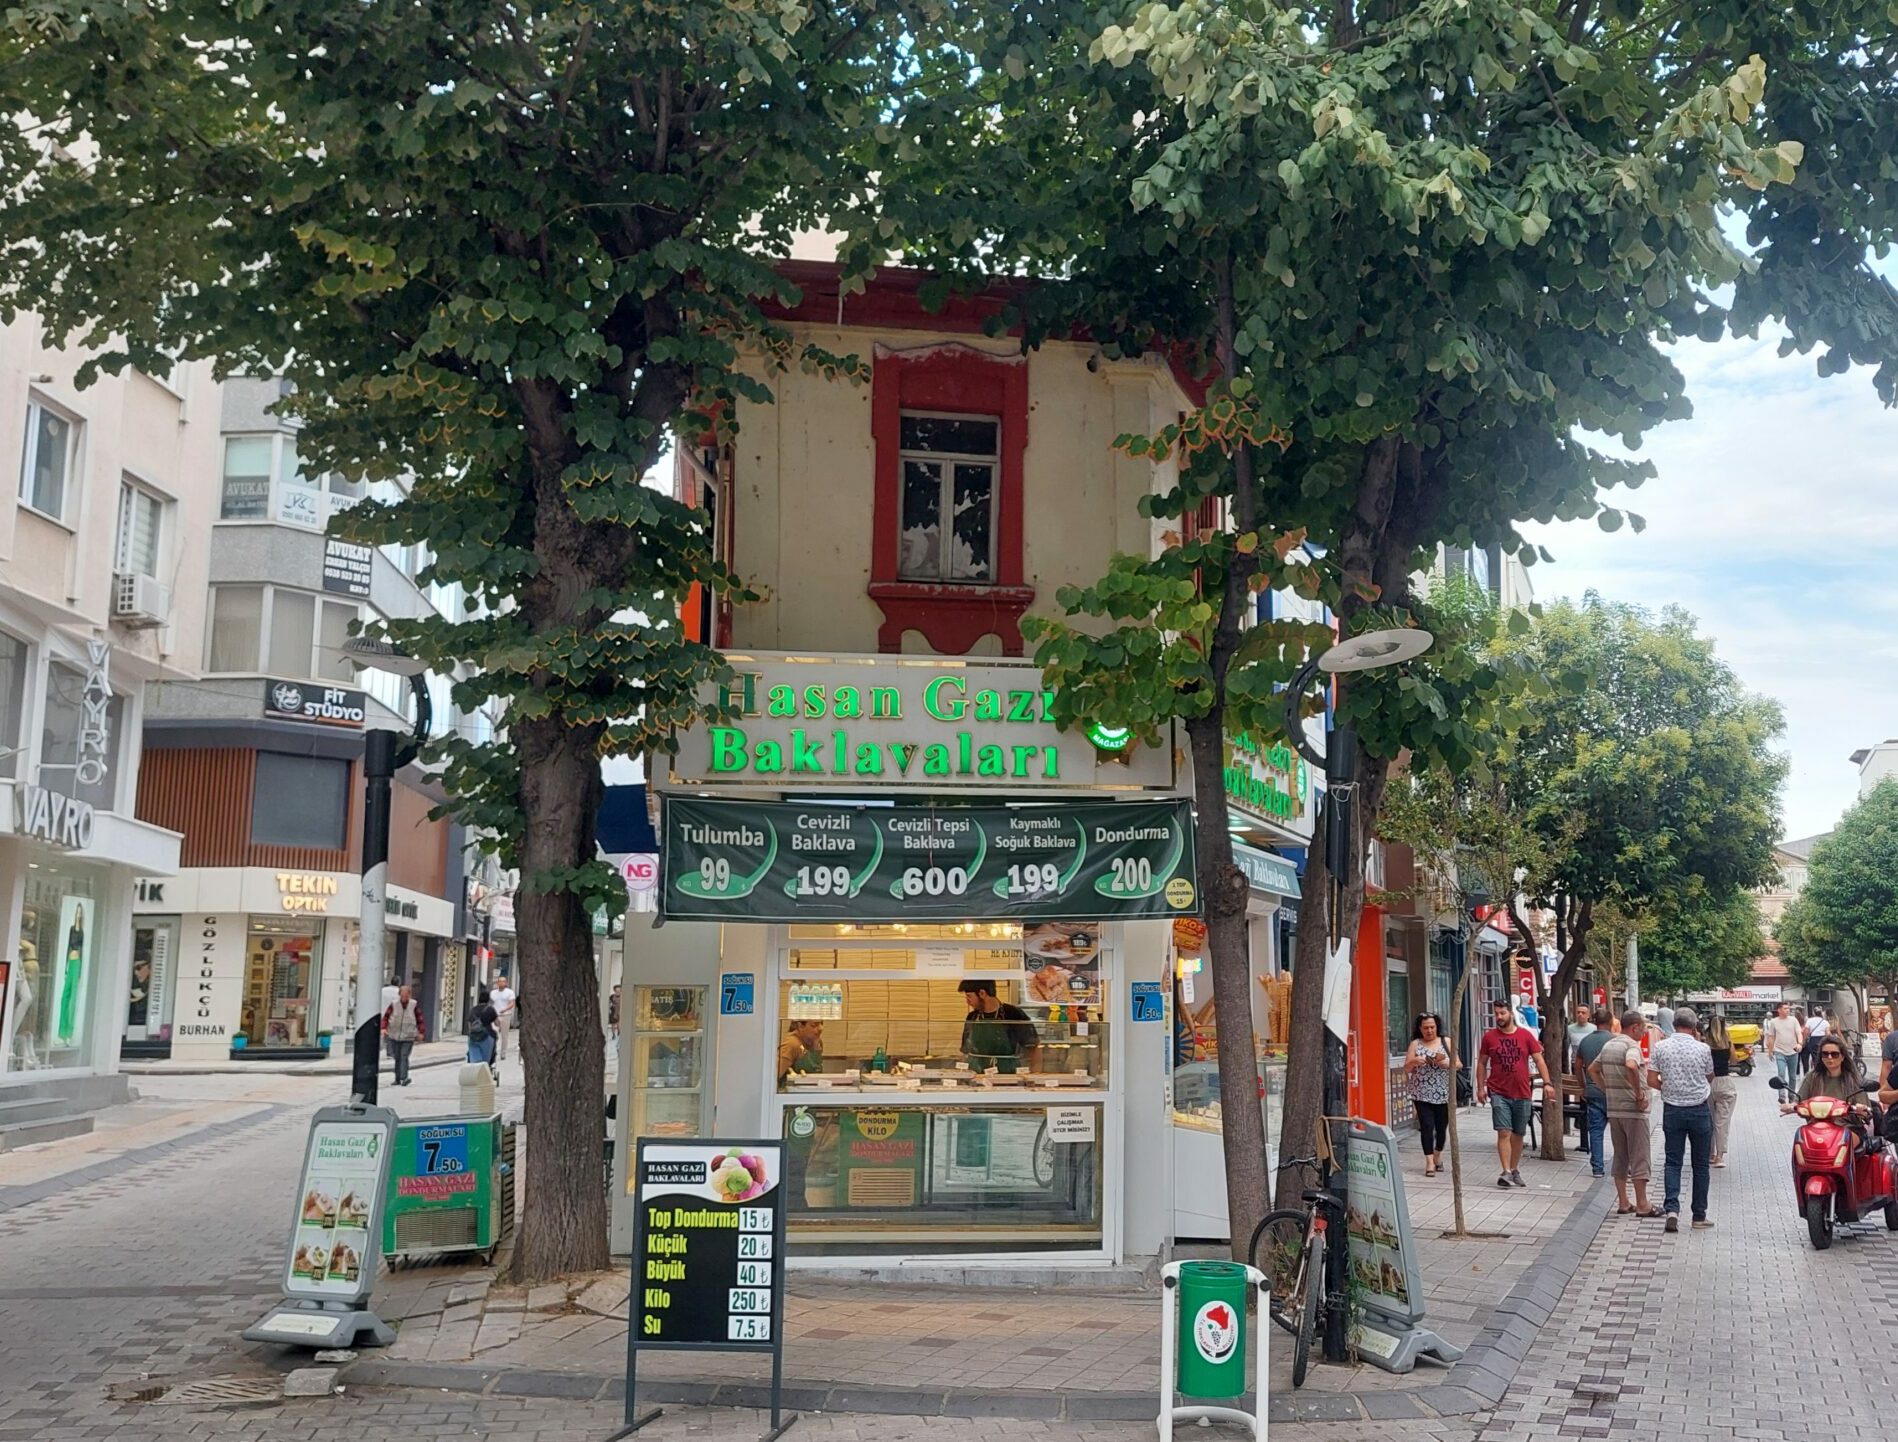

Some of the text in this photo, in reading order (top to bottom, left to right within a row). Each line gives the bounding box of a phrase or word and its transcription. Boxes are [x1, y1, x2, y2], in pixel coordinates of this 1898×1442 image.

[226, 482, 270, 496] AVUKAT
[330, 496, 360, 508] AVUKA
[327, 540, 371, 562] AVUKAT
[323, 687, 347, 705] FİT
[717, 671, 1058, 723] Hasan Gazi
[76, 640, 114, 786] VAYRO
[304, 701, 363, 721] STÜDYO
[708, 727, 1060, 779] Baklavaları
[24, 782, 95, 850] VAYRO
[796, 814, 851, 830] Cevizli
[888, 818, 970, 835] Cevizli Tepsi
[1009, 818, 1062, 833] Kaymaklı
[679, 823, 765, 847] Tulumba
[791, 834, 856, 851] Baklava
[903, 835, 956, 849] Baklava
[995, 835, 1077, 851] Soğuk Baklava
[1095, 826, 1170, 843] Dondurma
[627, 864, 652, 878] NG
[700, 856, 730, 892] 99
[1008, 863, 1061, 894] 199
[1111, 857, 1152, 892] 200
[797, 866, 850, 896] 199
[902, 866, 969, 896] 600
[134, 879, 165, 902] İK
[282, 895, 328, 913] OPTİK
[1280, 905, 1298, 924] SERVİS
[198, 916, 217, 1018] GÖZLÜKÇÜ
[724, 974, 744, 984] SOĞUK
[1752, 992, 1779, 1000] market
[179, 1025, 226, 1036] BURHAN
[1499, 1038, 1518, 1048] YOU
[1499, 1055, 1520, 1065] STOP
[858, 1117, 897, 1125] DONDURMA
[420, 1126, 465, 1139] SOĞUK SU
[867, 1126, 887, 1136] KİLO
[320, 1135, 366, 1147] Hasan Gazi
[318, 1147, 364, 1158] Baklavaları
[648, 1164, 679, 1173] HASAN
[399, 1175, 441, 1187] HASAN
[647, 1174, 705, 1183] BAKLAVALARI
[649, 1208, 671, 1230] Top
[674, 1208, 739, 1229] Dondurma
[742, 1210, 758, 1229] 15
[647, 1234, 688, 1257] Küçük
[740, 1237, 757, 1256] 20
[646, 1260, 686, 1282] Büyük
[739, 1266, 756, 1284] 40
[644, 1288, 671, 1309] Kilo
[731, 1291, 757, 1310] 250
[644, 1315, 662, 1334] Su
[735, 1319, 756, 1338] 7.5
